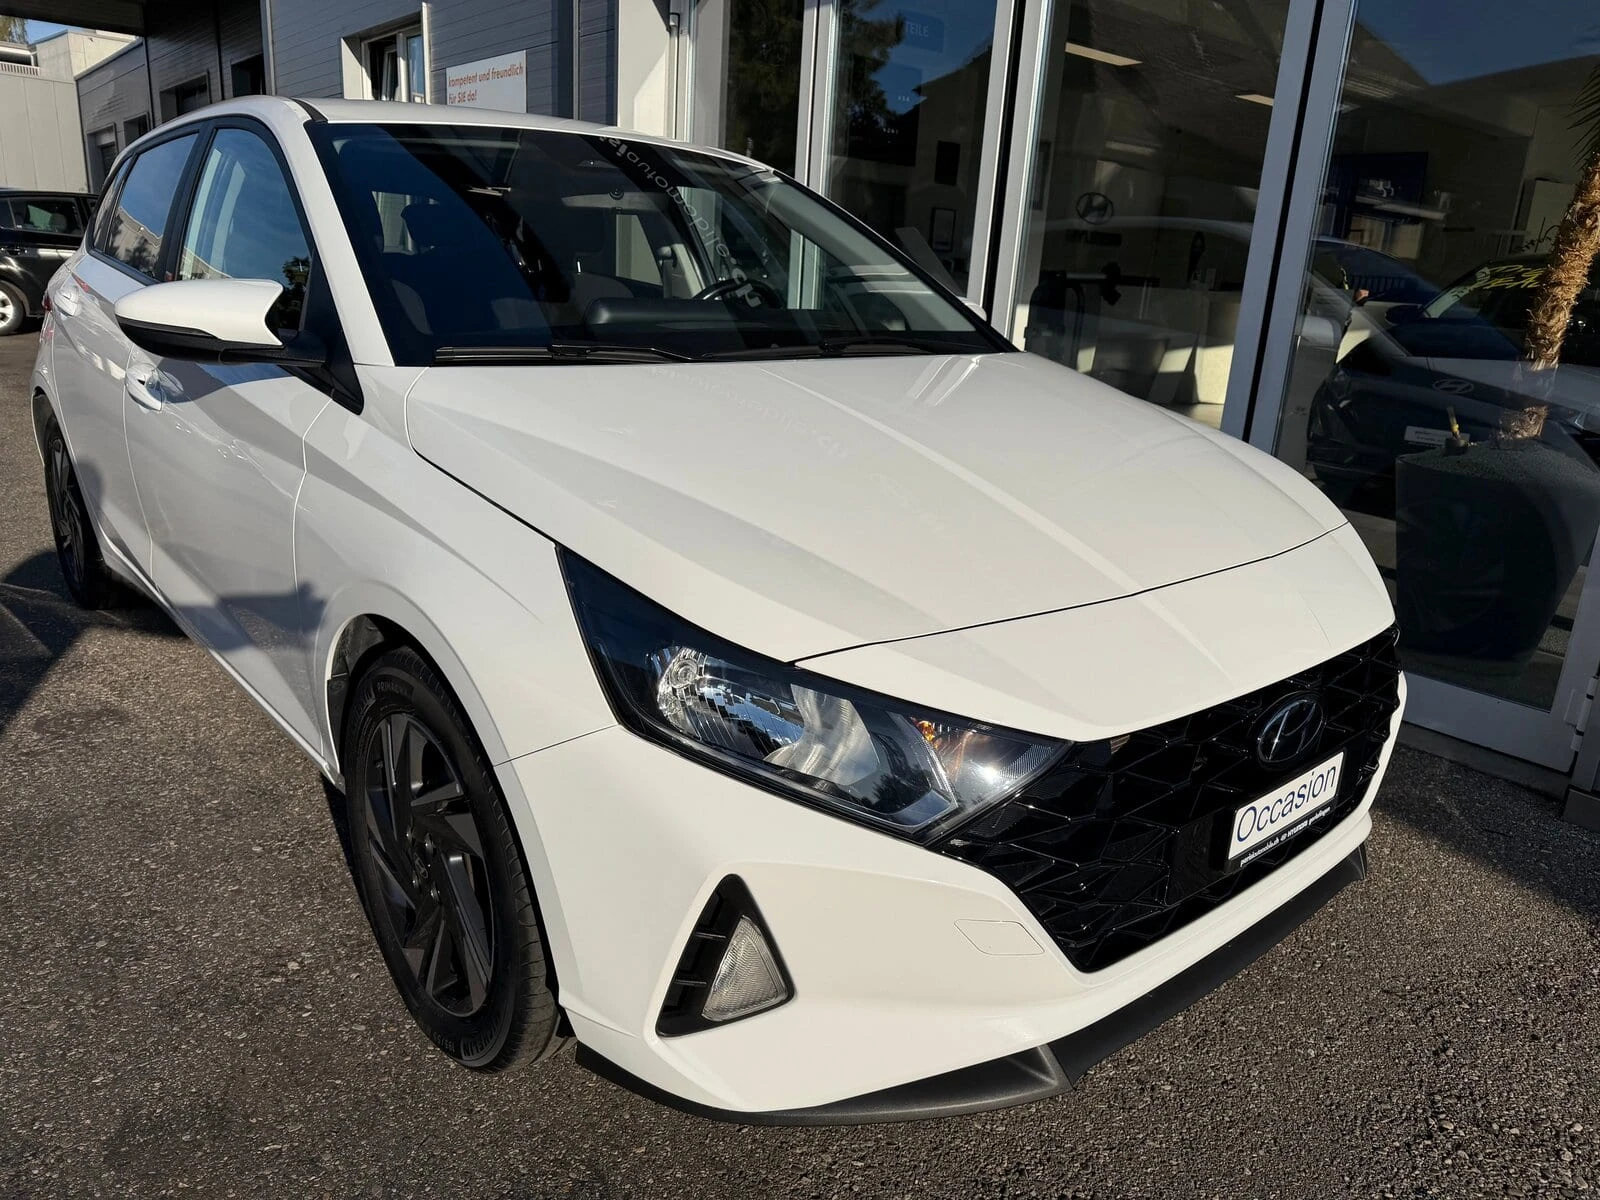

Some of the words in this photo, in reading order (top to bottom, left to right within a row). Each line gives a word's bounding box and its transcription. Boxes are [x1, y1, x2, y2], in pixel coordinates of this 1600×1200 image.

[449, 72, 477, 88] kompetent
[479, 68, 490, 81] und
[492, 62, 523, 80] freundlich
[457, 91, 466, 103] SIE
[467, 89, 477, 101] da!
[1236, 765, 1337, 843] Occasion
